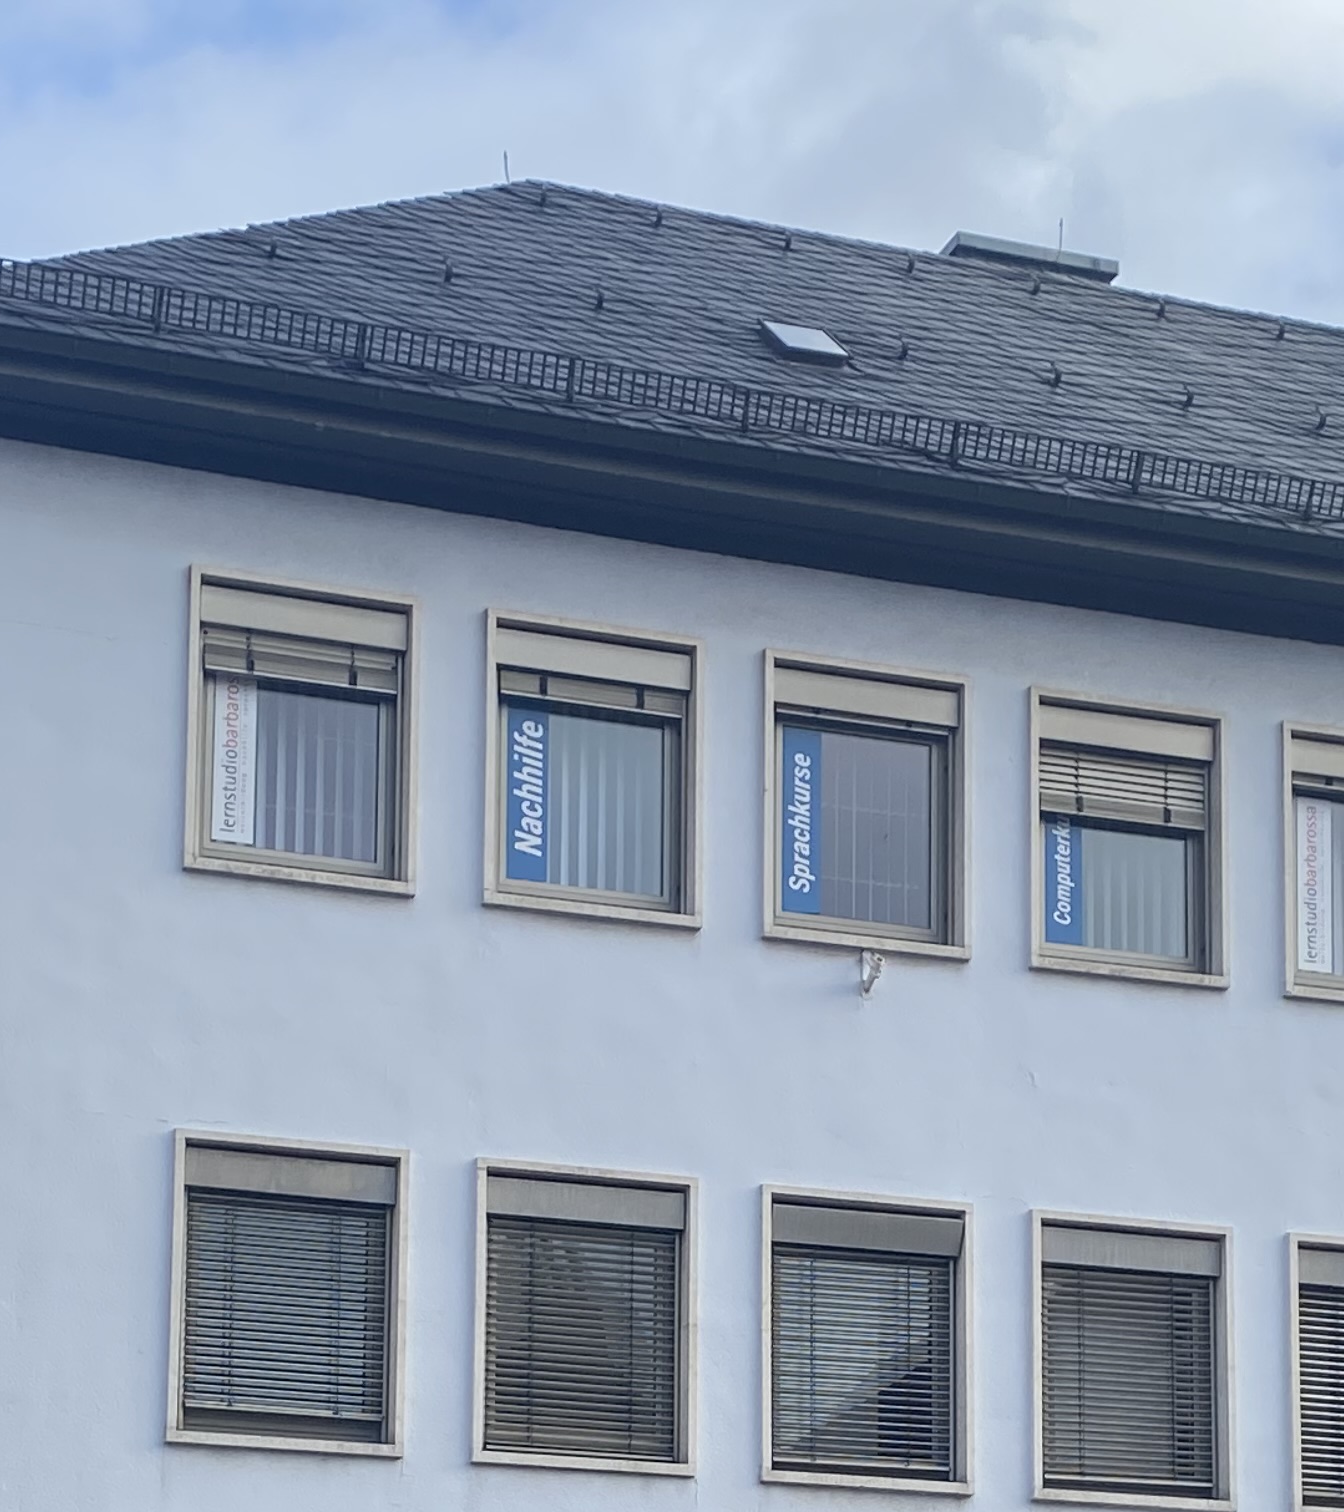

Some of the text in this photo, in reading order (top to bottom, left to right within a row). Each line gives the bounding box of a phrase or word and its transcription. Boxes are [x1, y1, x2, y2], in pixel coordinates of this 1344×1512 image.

[219, 676, 240, 833] lernstudiobarbaros
[513, 718, 546, 858] Nachhilfe
[788, 751, 813, 894] Sprachkurse
[1052, 815, 1075, 925] Computerku
[1303, 805, 1318, 964] lernstudiobarbarossa
